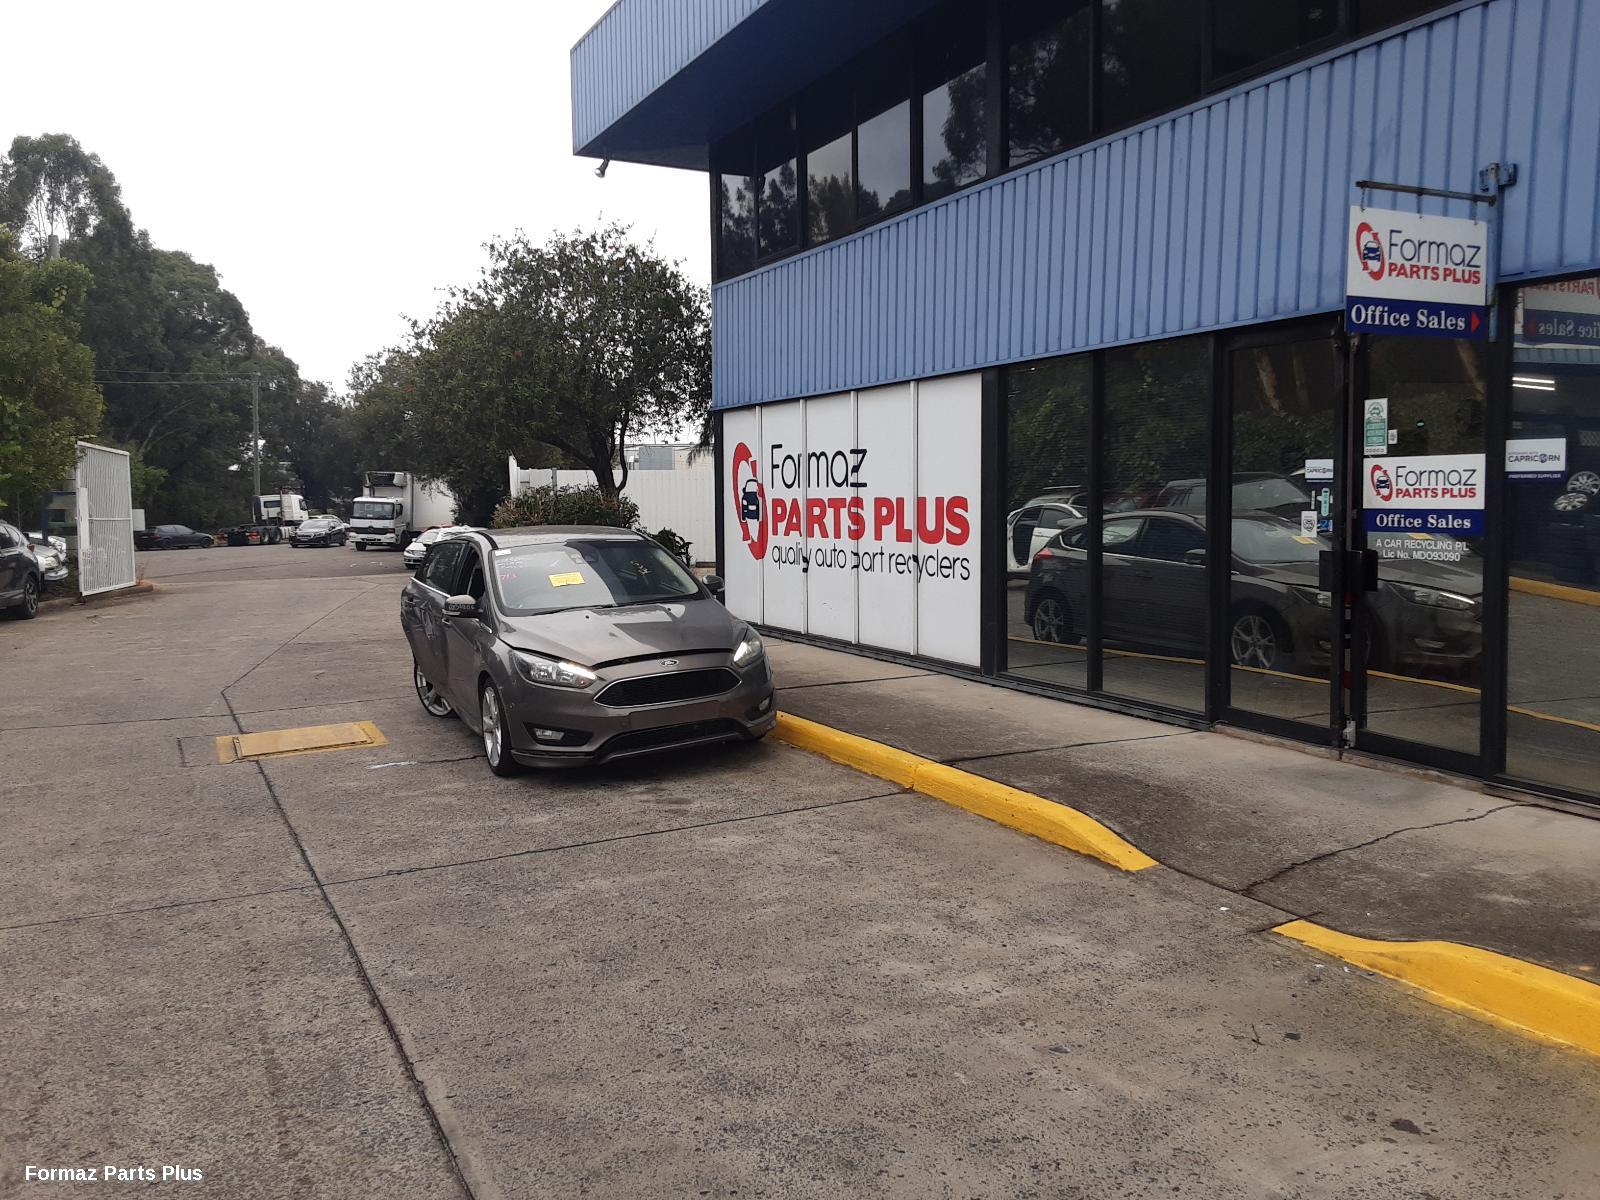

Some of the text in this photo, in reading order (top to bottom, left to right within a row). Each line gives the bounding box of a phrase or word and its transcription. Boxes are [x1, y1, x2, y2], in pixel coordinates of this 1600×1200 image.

[1388, 229, 1482, 269] Formaz
[1388, 262, 1481, 285] PARTS PLUS
[1351, 304, 1466, 331] Office Sales
[771, 443, 867, 490] Formaz
[1395, 465, 1477, 487] Formaz
[1395, 487, 1477, 498] PARTS PLUS
[772, 495, 970, 546] PARTS PLUS
[1376, 514, 1471, 529] Office Sales
[1376, 538, 1469, 551] A CAR RECYCLING P/L
[1383, 549, 1394, 558] Lic
[1397, 550, 1410, 559] No.
[772, 541, 812, 573] qualiy
[815, 542, 847, 569] auto
[889, 548, 970, 584] recyclers
